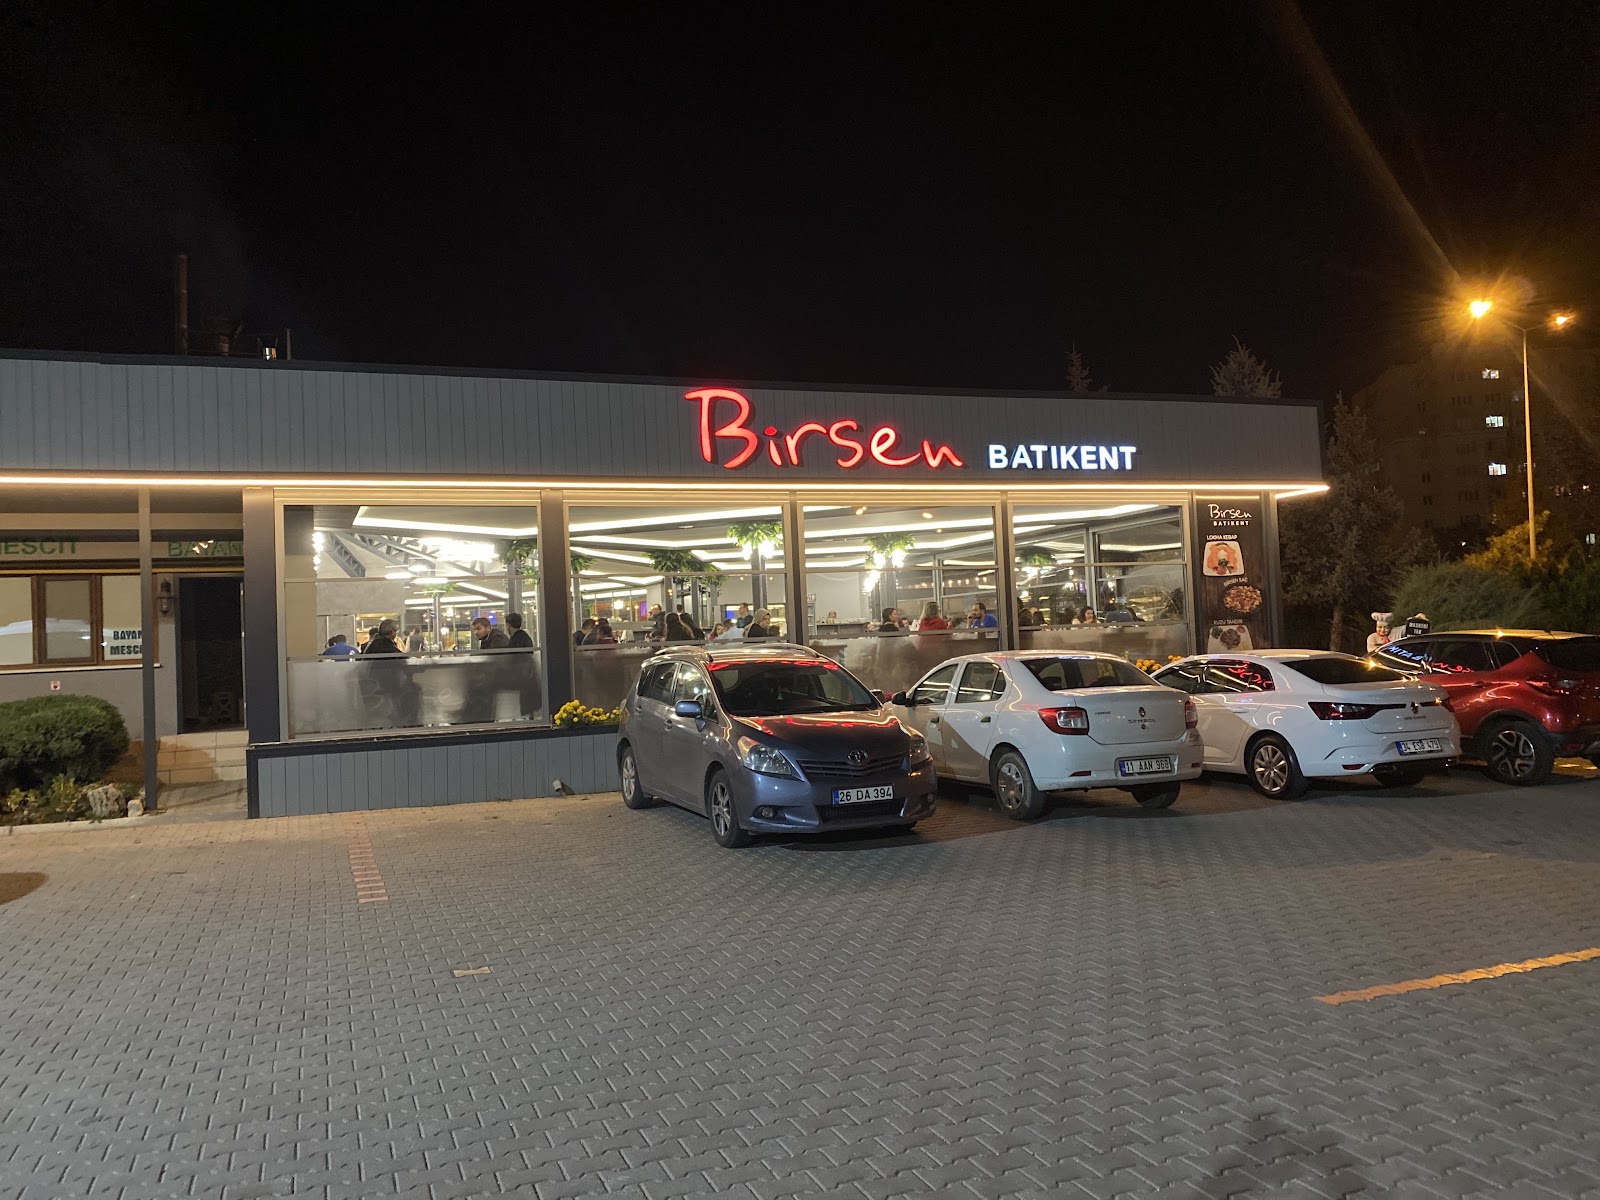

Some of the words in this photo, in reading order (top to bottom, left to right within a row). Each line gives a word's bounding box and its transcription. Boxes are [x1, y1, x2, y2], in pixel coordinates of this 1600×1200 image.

[683, 387, 963, 469] Birsen
[988, 443, 1137, 471] BATIKENT
[1207, 503, 1252, 519] Birsen
[1126, 761, 1134, 772] 11
[1139, 760, 1153, 771] AAN
[1156, 759, 1169, 770] 968
[839, 791, 852, 802] 26
[856, 789, 871, 801] DA
[873, 787, 892, 799] 394
